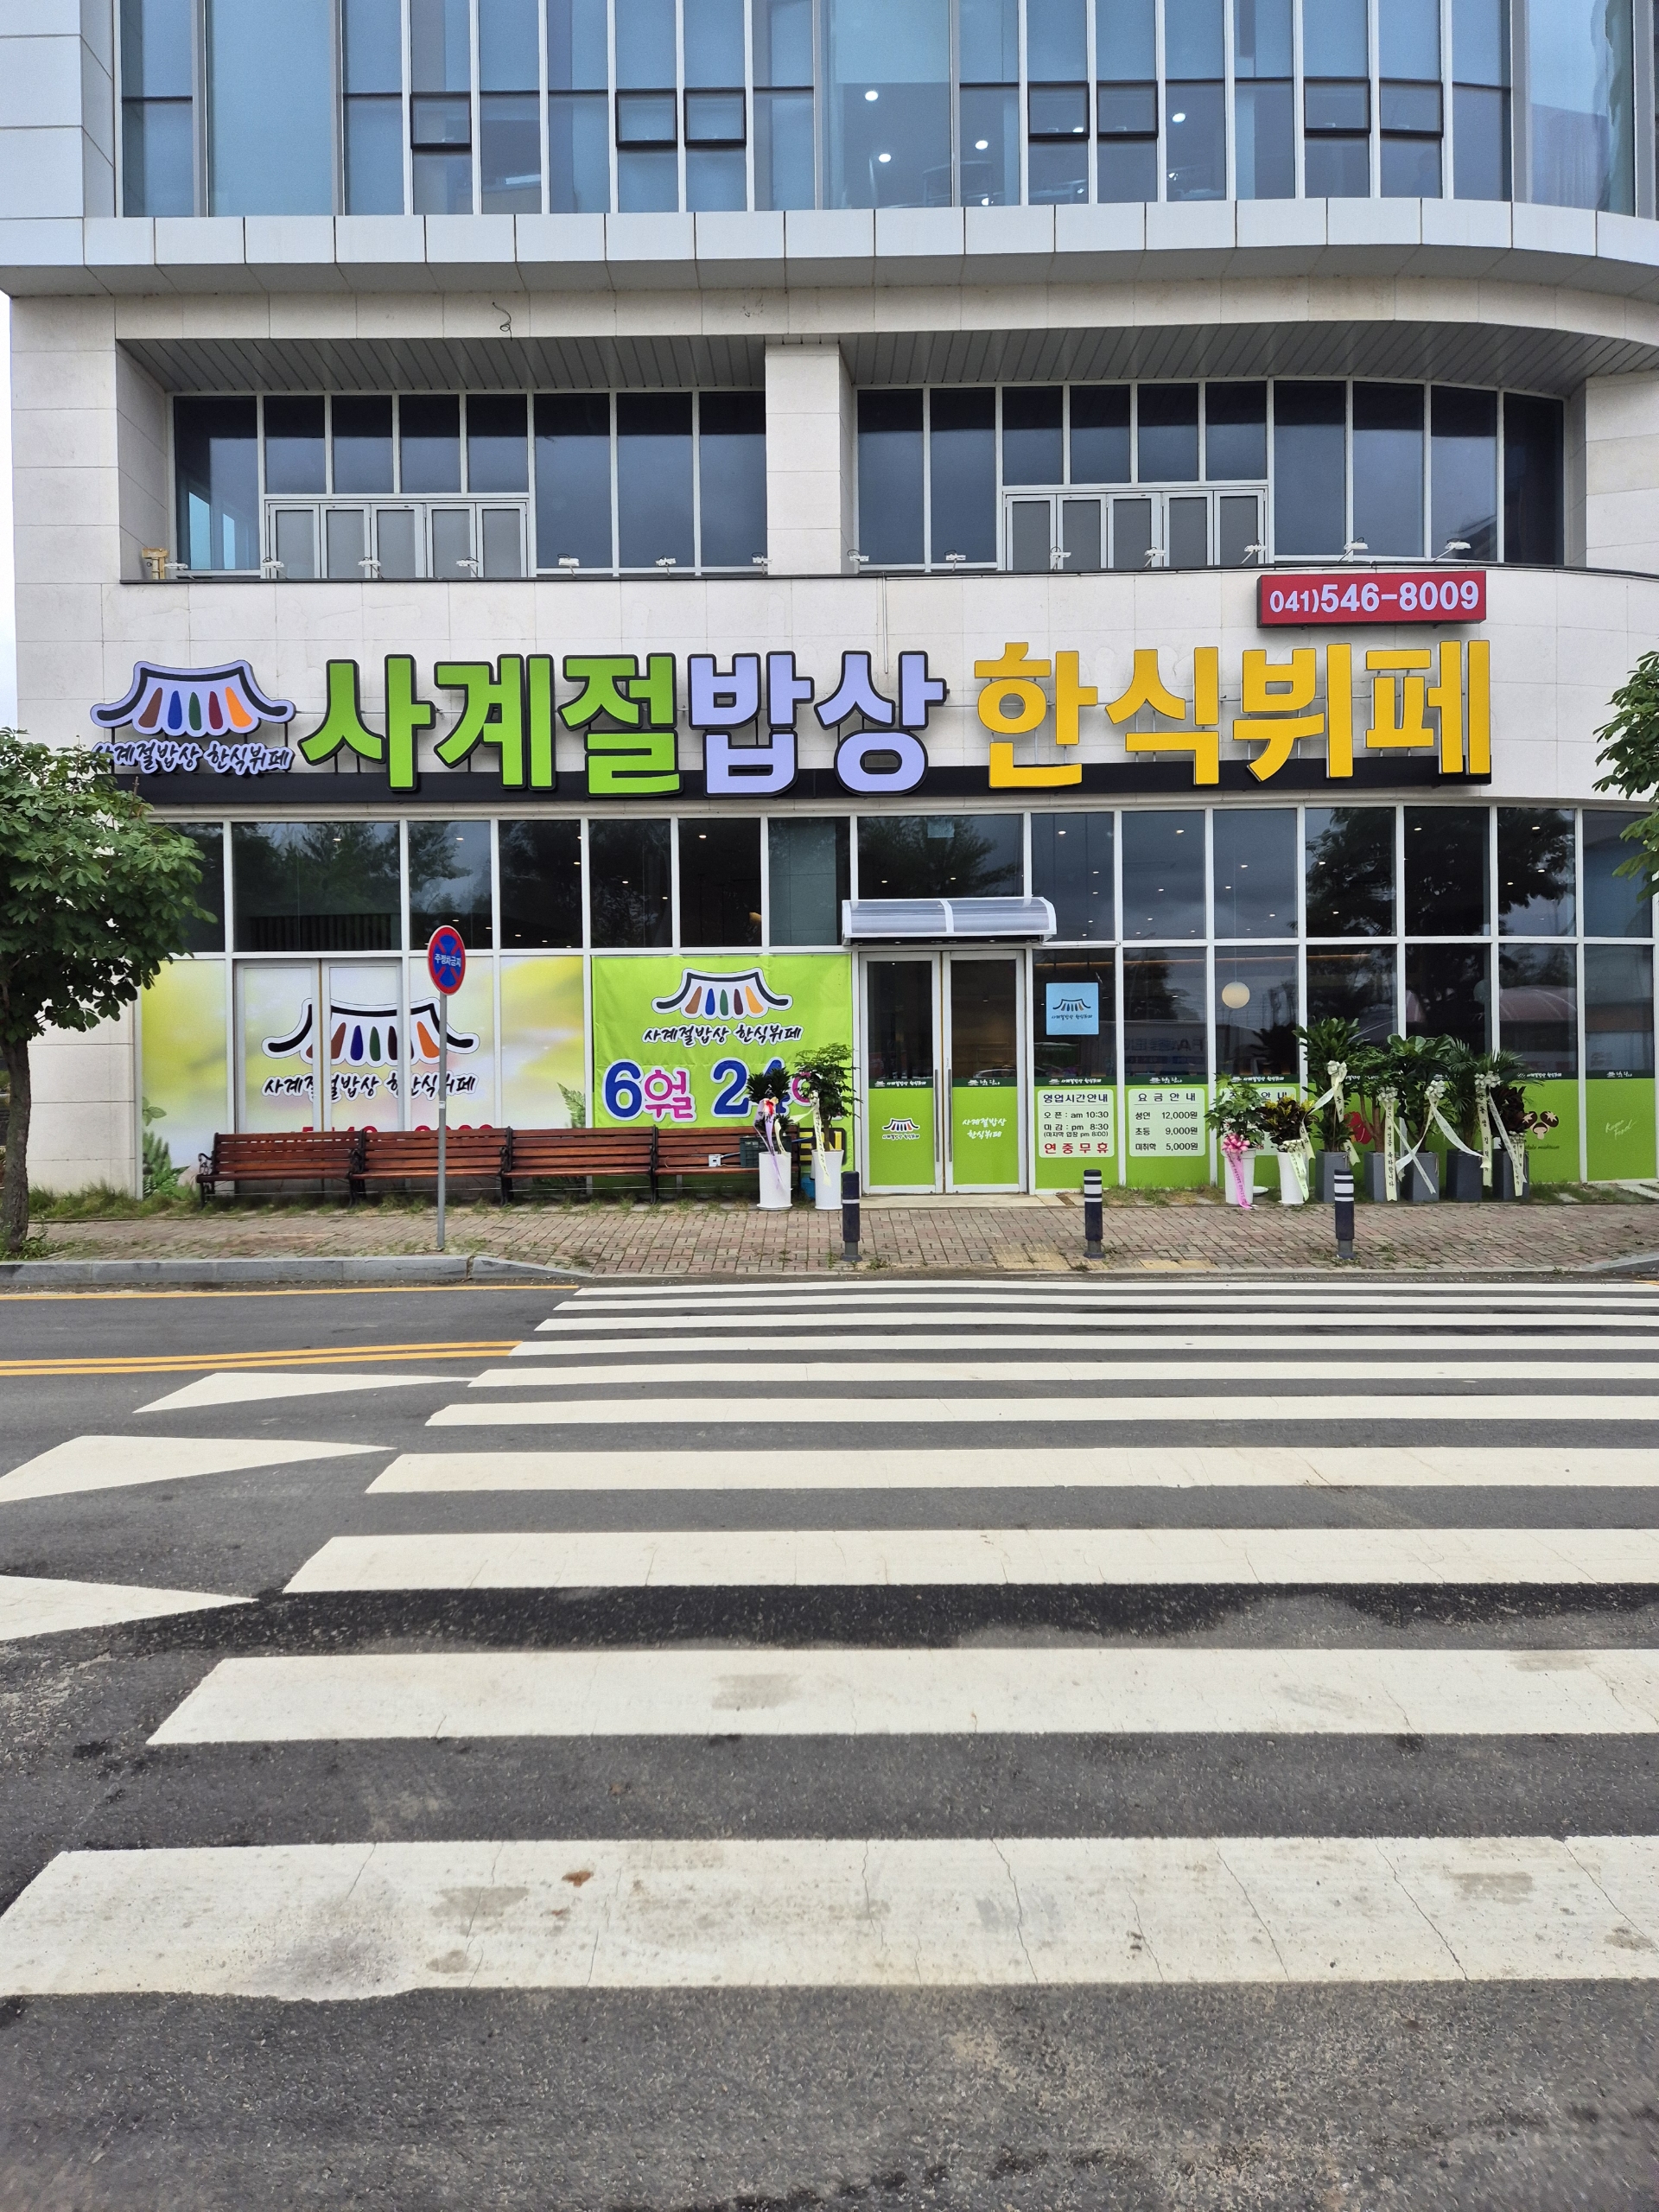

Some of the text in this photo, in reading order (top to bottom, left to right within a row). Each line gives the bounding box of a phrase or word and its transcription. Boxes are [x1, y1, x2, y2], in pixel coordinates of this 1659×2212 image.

[1270, 581, 1480, 613] 041)546-8009
[298, 640, 1491, 797] 사계절밥상 한식뷔페
[207, 743, 289, 772] 한식뷔페
[435, 953, 461, 968] 주정차금지
[644, 1025, 802, 1046] 사계절밥상 한식뷔페
[605, 1060, 694, 1120] 6월
[1043, 1093, 1109, 1103] 영업시간안내
[1135, 1110, 1198, 1121] 성인 12,000원
[1135, 1127, 1198, 1136] 초등 9,000원
[1135, 1142, 1198, 1152] 미취학 5,000원
